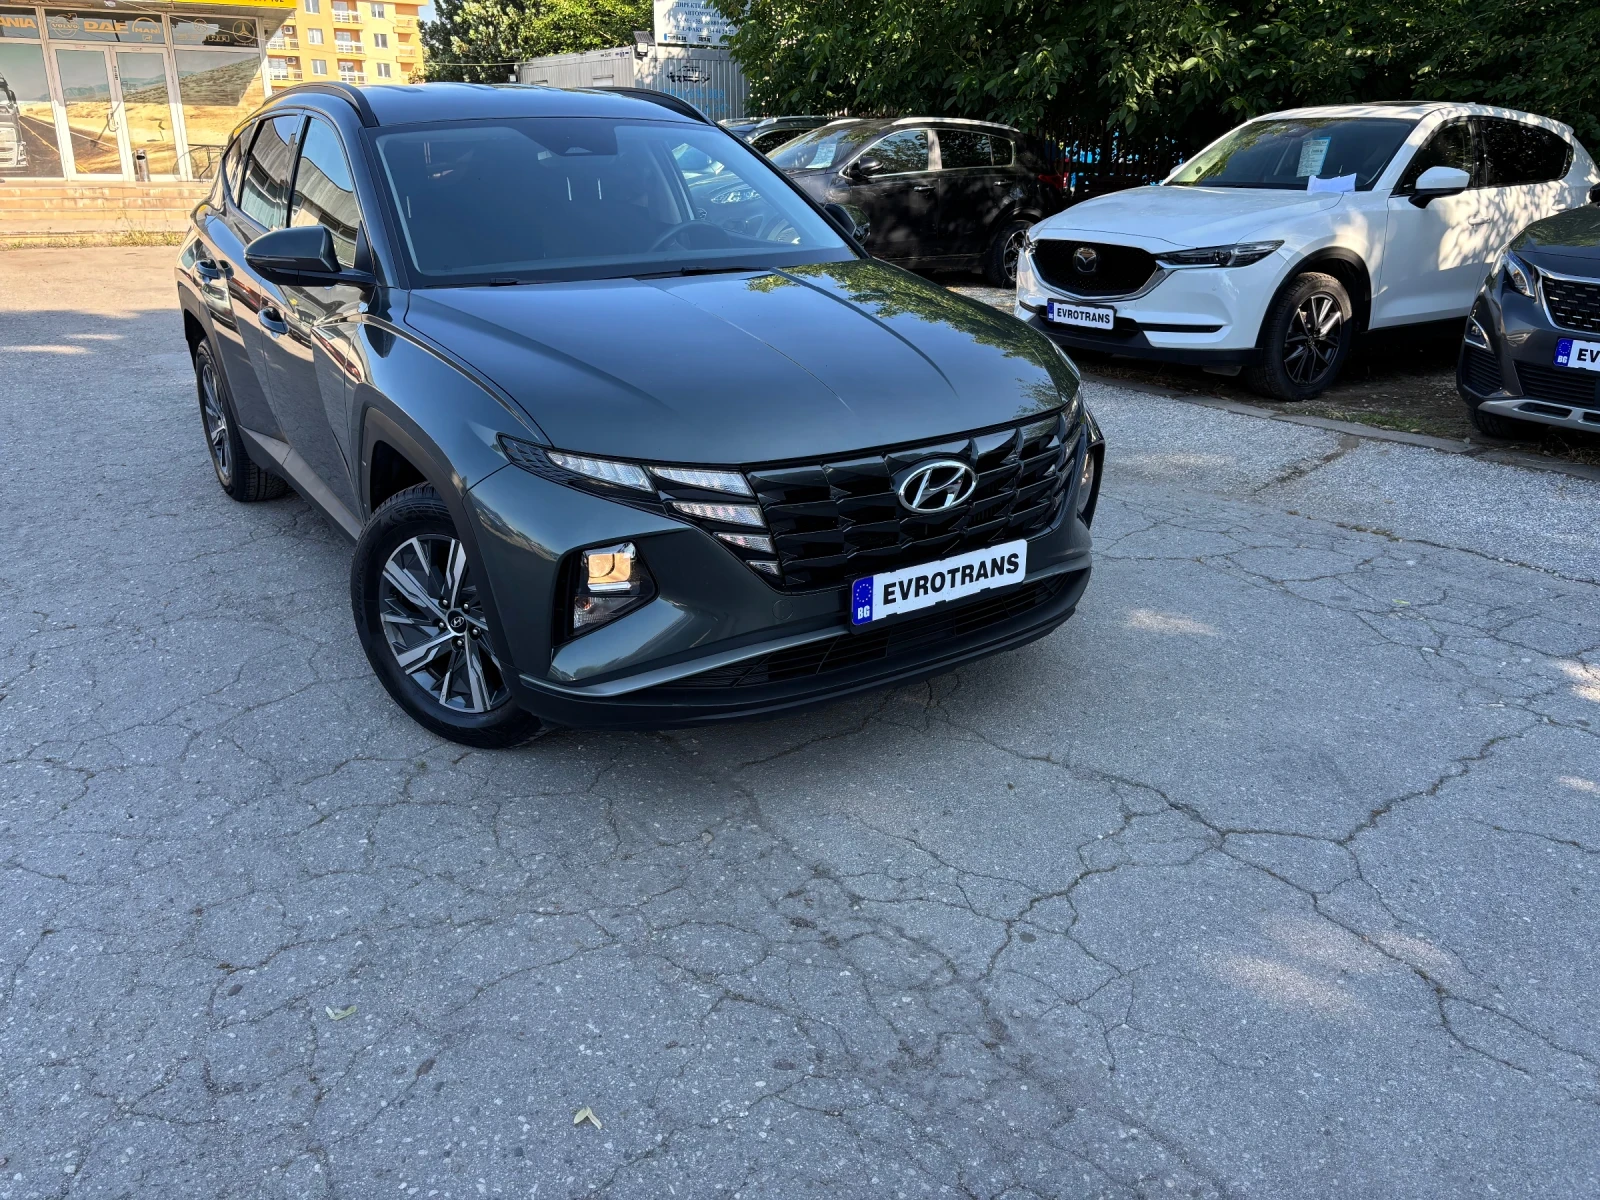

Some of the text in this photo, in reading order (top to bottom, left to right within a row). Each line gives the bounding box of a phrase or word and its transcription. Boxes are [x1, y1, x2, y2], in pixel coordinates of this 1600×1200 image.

[83, 20, 128, 32] DAF
[1057, 308, 1110, 324] EVROTRANS
[1557, 355, 1568, 364] BG
[883, 553, 1019, 605] EVROTRANS
[857, 605, 870, 620] BG
